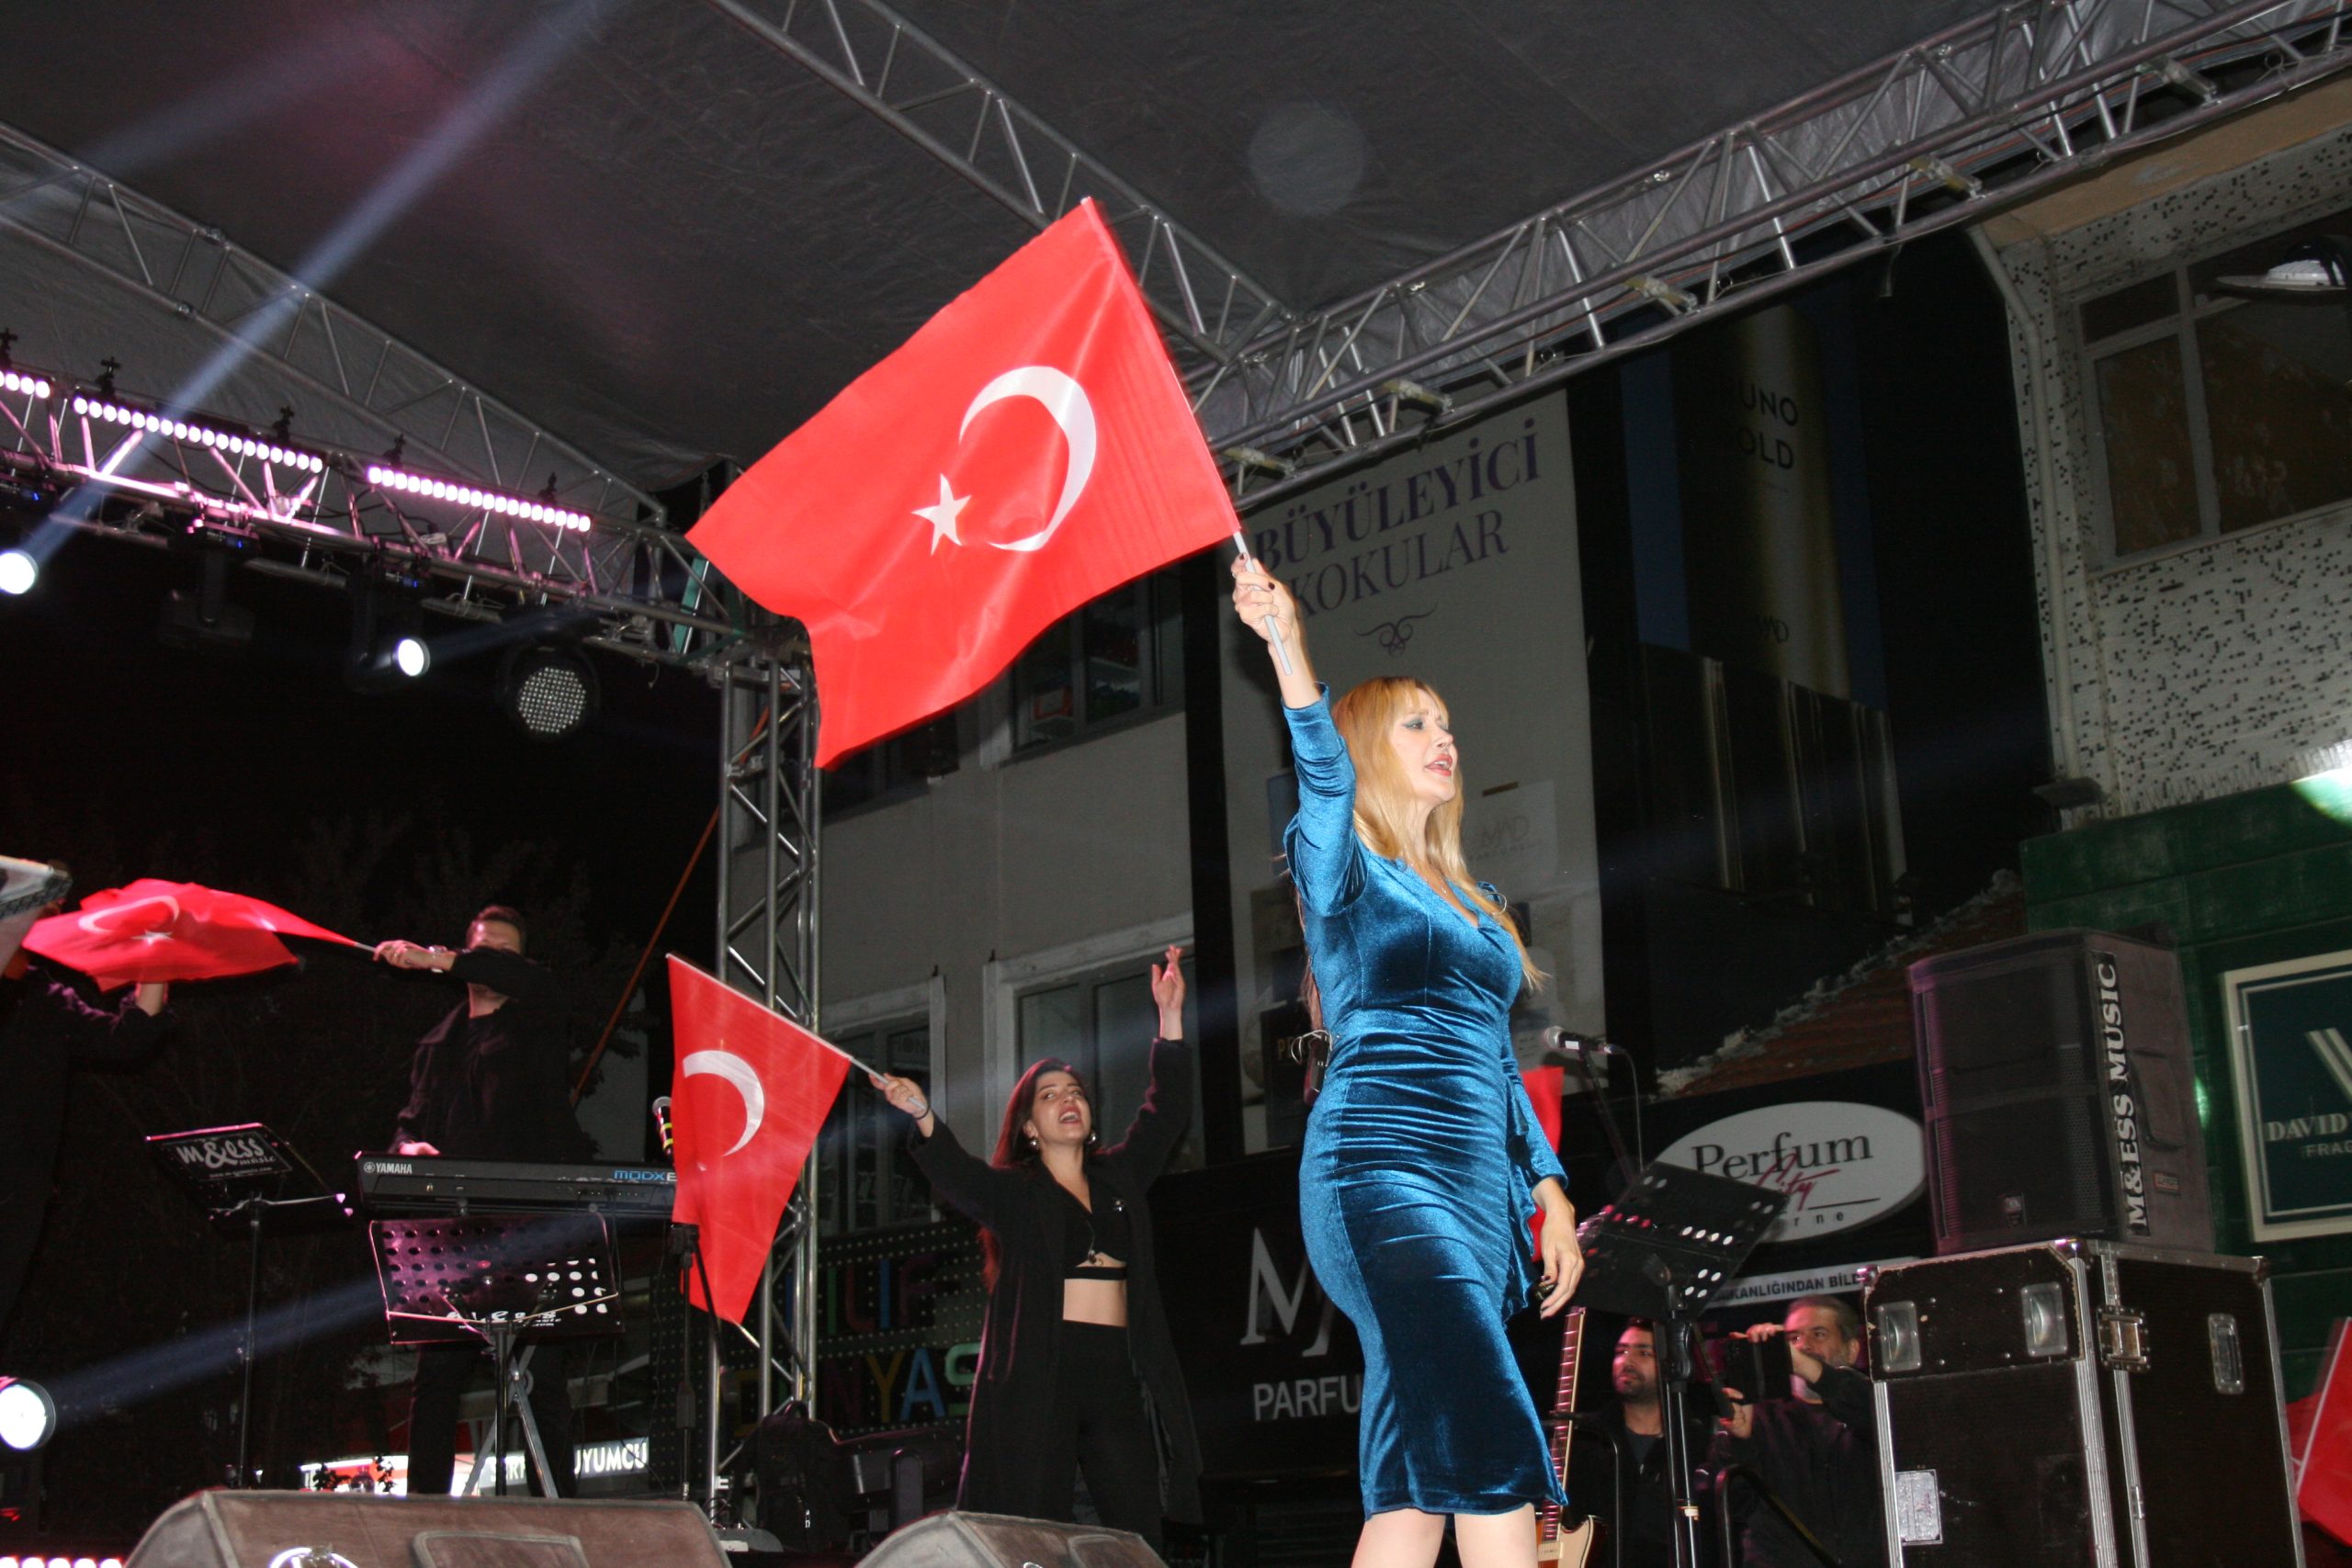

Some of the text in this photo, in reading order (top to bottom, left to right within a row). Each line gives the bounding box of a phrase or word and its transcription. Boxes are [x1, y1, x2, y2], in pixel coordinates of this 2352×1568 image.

[1739, 380, 1799, 426] UNO
[1737, 425, 1794, 469] OLD
[1255, 417, 1542, 572] BÜYÜLEYİCİ
[1290, 509, 1510, 617] KOKULAR
[2098, 964, 2129, 1082] MUSIC
[2264, 1112, 2350, 1142] DAVID
[2305, 1142, 2352, 1158] FRAG
[376, 1162, 413, 1175] YAMAHA
[1691, 1131, 1874, 1179] Perfum
[1253, 1374, 1362, 1421] PARFU
